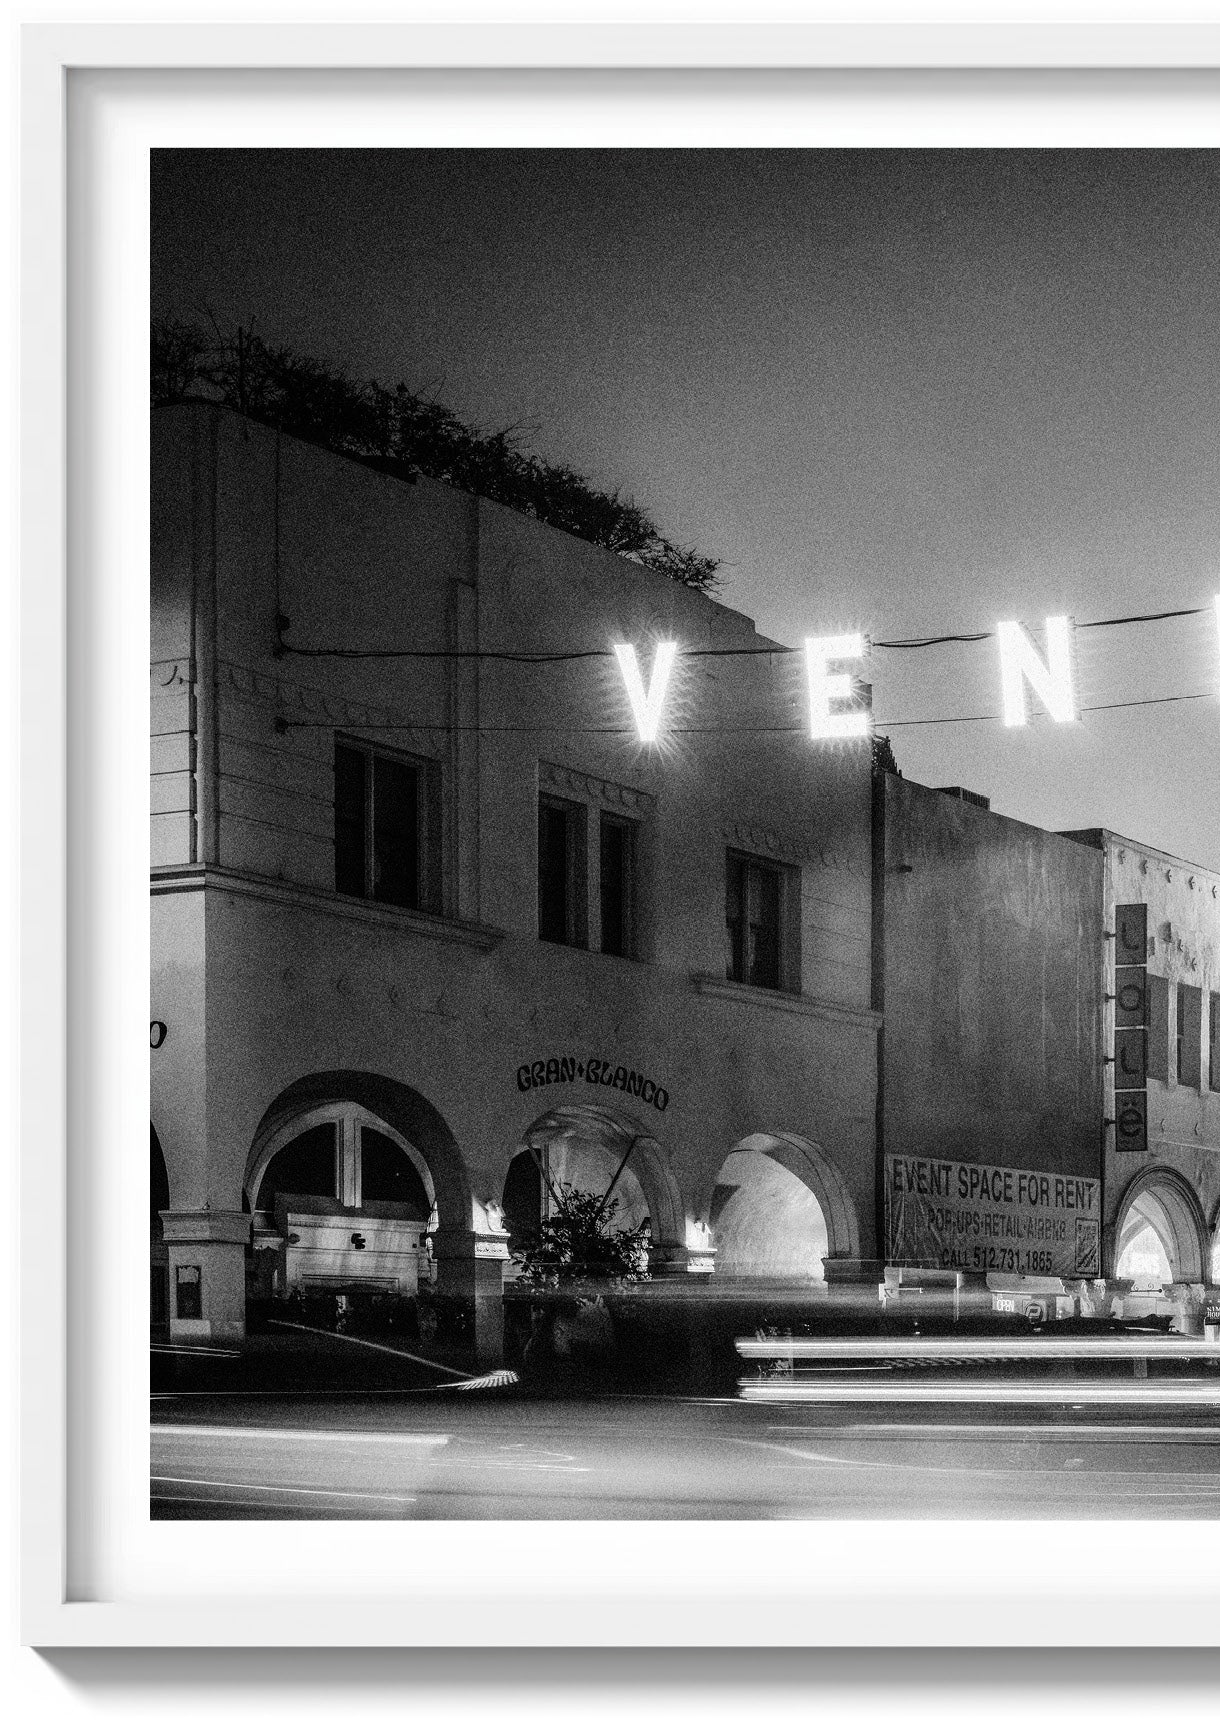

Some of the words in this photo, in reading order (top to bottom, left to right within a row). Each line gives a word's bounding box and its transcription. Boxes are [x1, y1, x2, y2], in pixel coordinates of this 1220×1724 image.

[516, 1057, 576, 1092] GRAN
[585, 1058, 670, 1112] BLANCO
[892, 1158, 952, 1197] EVENT
[957, 1165, 1013, 1203] SPACE
[1018, 1173, 1050, 1206] FOR
[1054, 1178, 1096, 1210] RENT
[942, 1247, 970, 1267] CALL
[973, 1246, 1053, 1272] 512.731.1865
